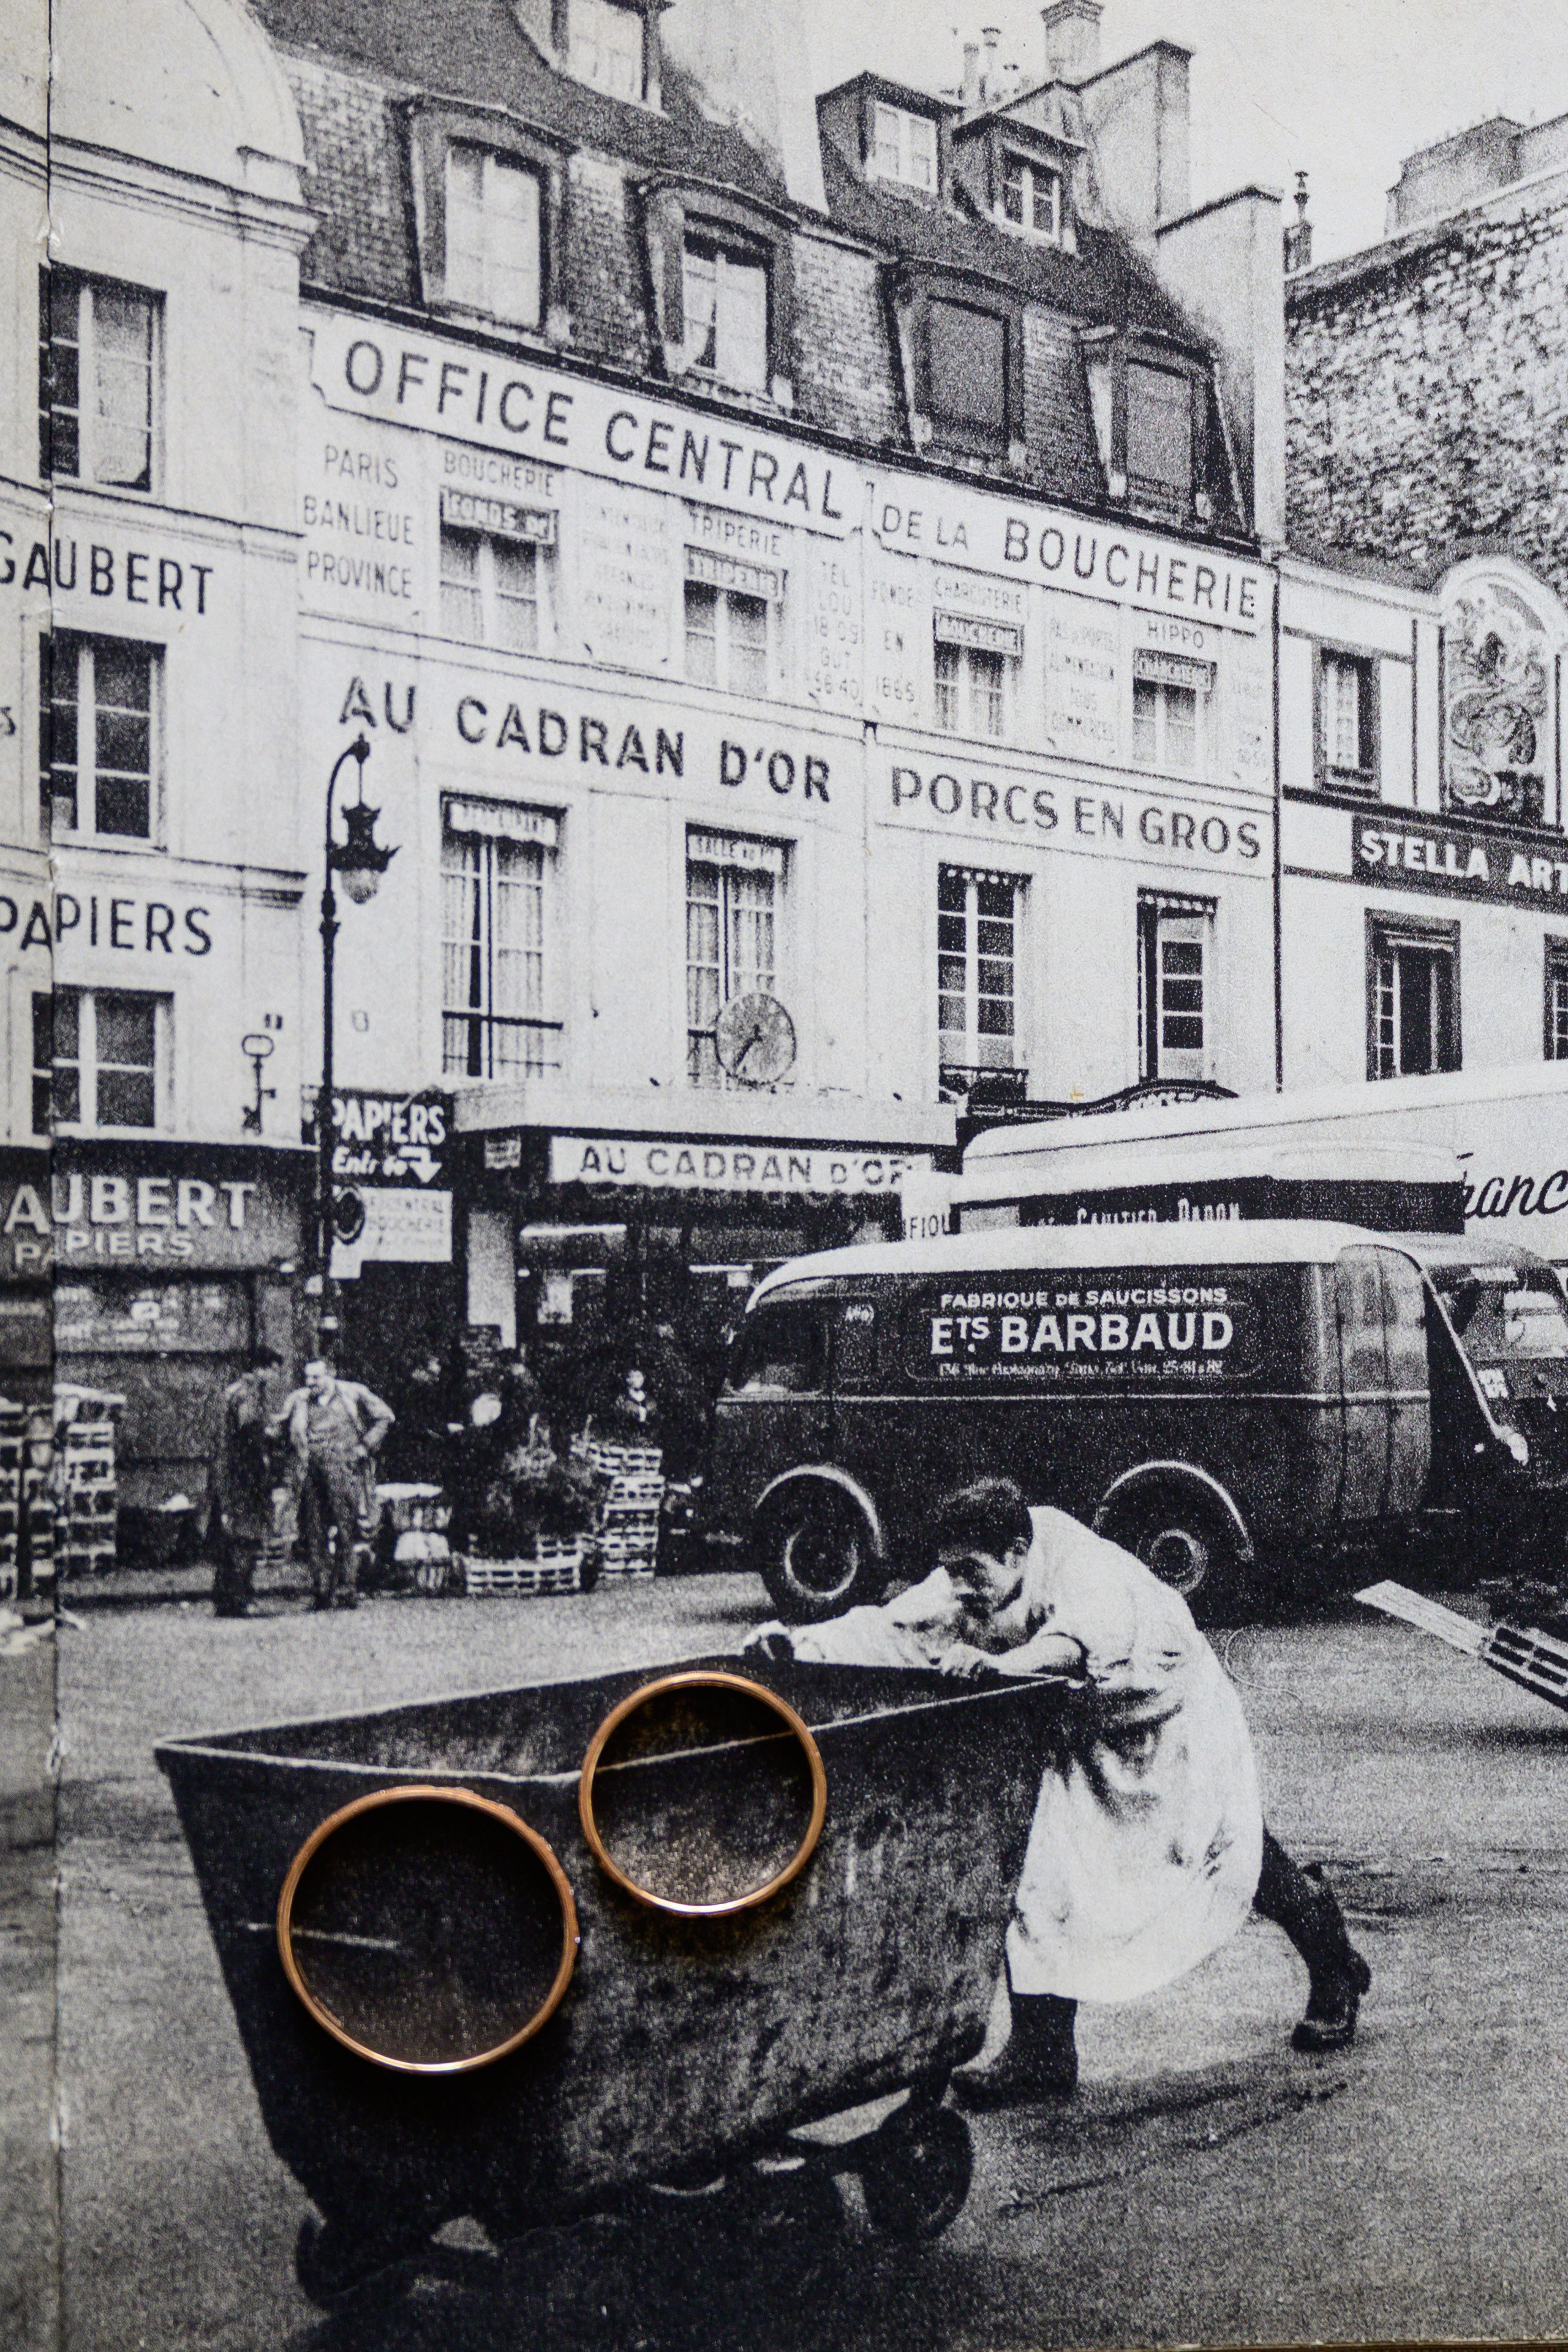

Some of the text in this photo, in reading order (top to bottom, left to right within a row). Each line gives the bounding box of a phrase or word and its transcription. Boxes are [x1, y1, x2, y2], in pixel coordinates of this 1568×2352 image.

[345, 341, 843, 519] OFFICE CENTRAL
[325, 444, 399, 489] PARIS
[444, 450, 555, 497] BOUCHERIE
[304, 495, 415, 545] BANLIEUE
[689, 511, 781, 556] TRIPERIE
[307, 551, 412, 598] PROVINCE
[882, 505, 1257, 619] DE LA BOUCHERIE
[1147, 619, 1204, 649] HIPPO
[339, 676, 831, 803] AU CADRAN D'OR
[892, 766, 1261, 859] PORCS EN GROS
[1360, 830, 1491, 881] STELLA
[0, 893, 212, 956] PAPIERS
[579, 1145, 627, 1175] AU
[646, 1149, 812, 1185] CADRAN
[14, 1228, 195, 1267] PAPIERS
[940, 1287, 1228, 1310] FABRIQUE DE SAUCISSONS
[1000, 1311, 1234, 1354] BARBAUD
